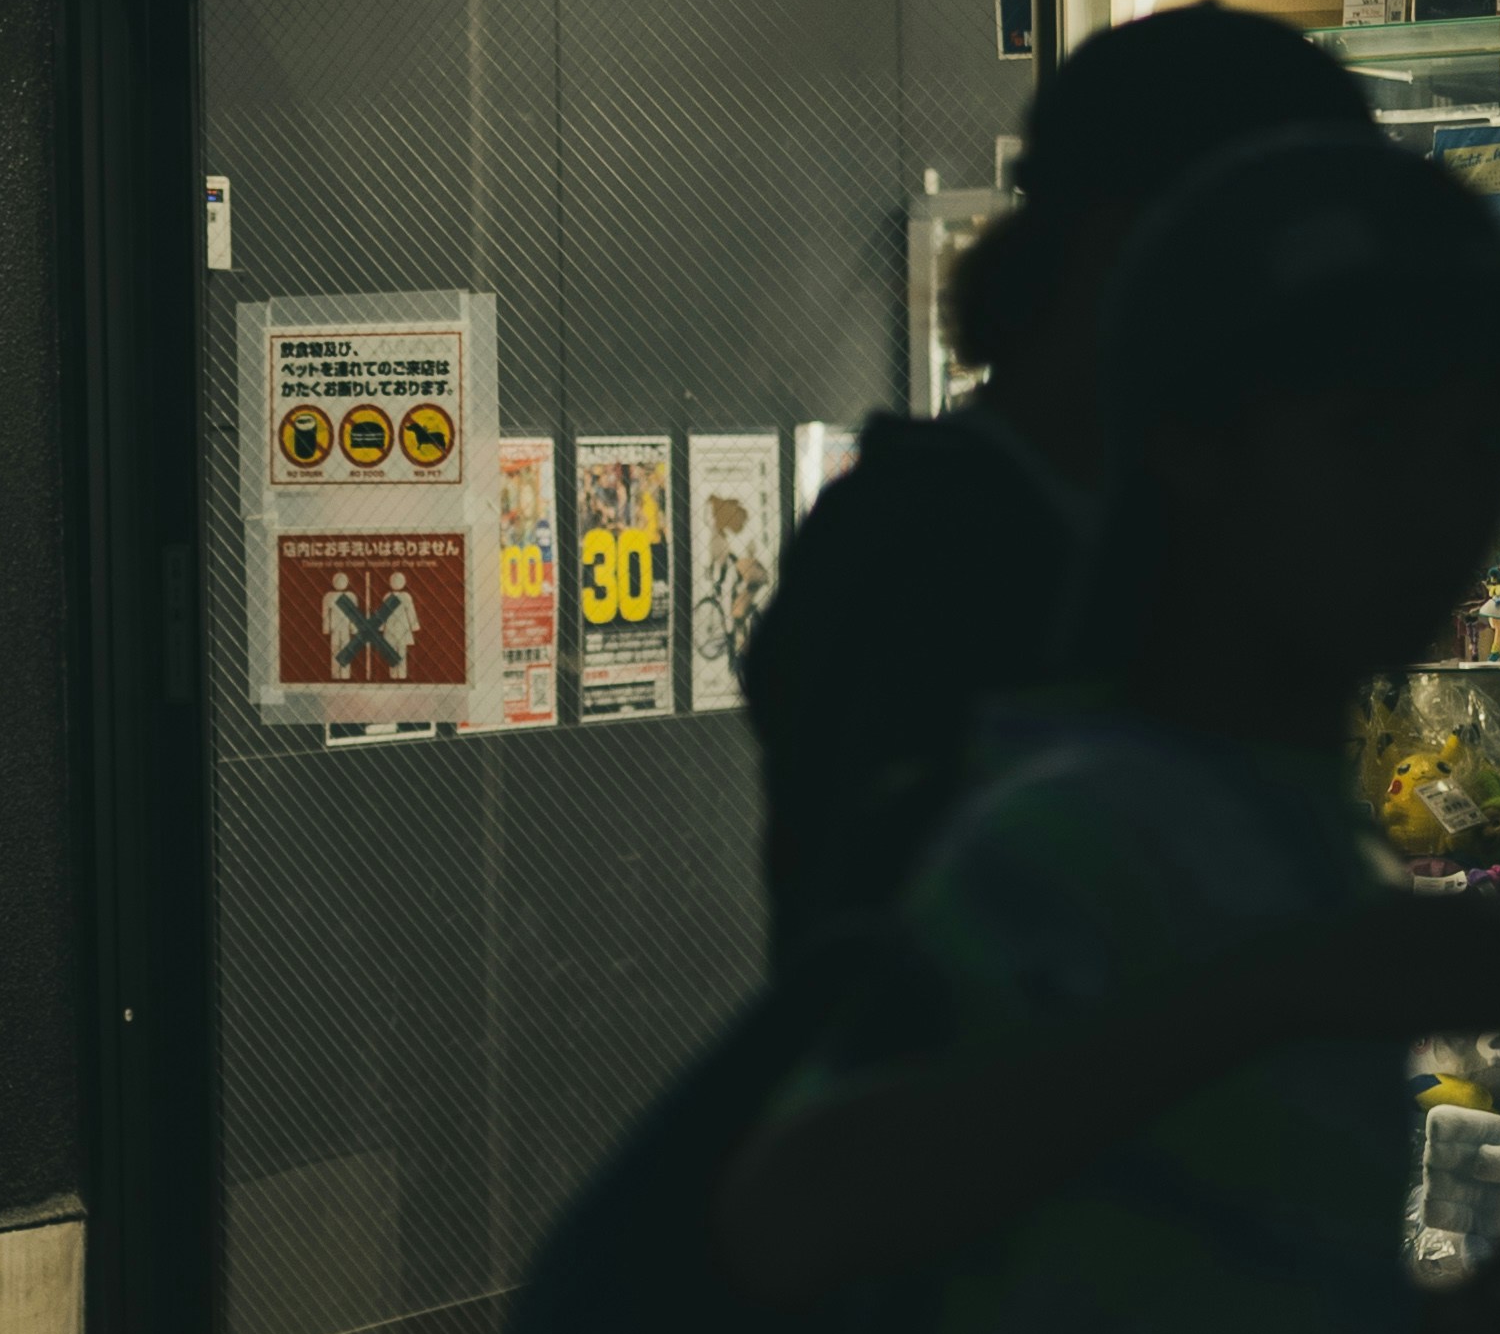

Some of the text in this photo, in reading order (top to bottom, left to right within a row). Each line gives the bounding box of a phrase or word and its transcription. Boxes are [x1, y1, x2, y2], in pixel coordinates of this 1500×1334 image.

[280, 341, 359, 358] 飲食物及び、
[281, 360, 450, 378] ペットを連れてのご来店は
[281, 380, 453, 398] かたくお断りしております。
[282, 540, 460, 558] 店内にお手洗いはありません
[581, 527, 653, 624] 30
